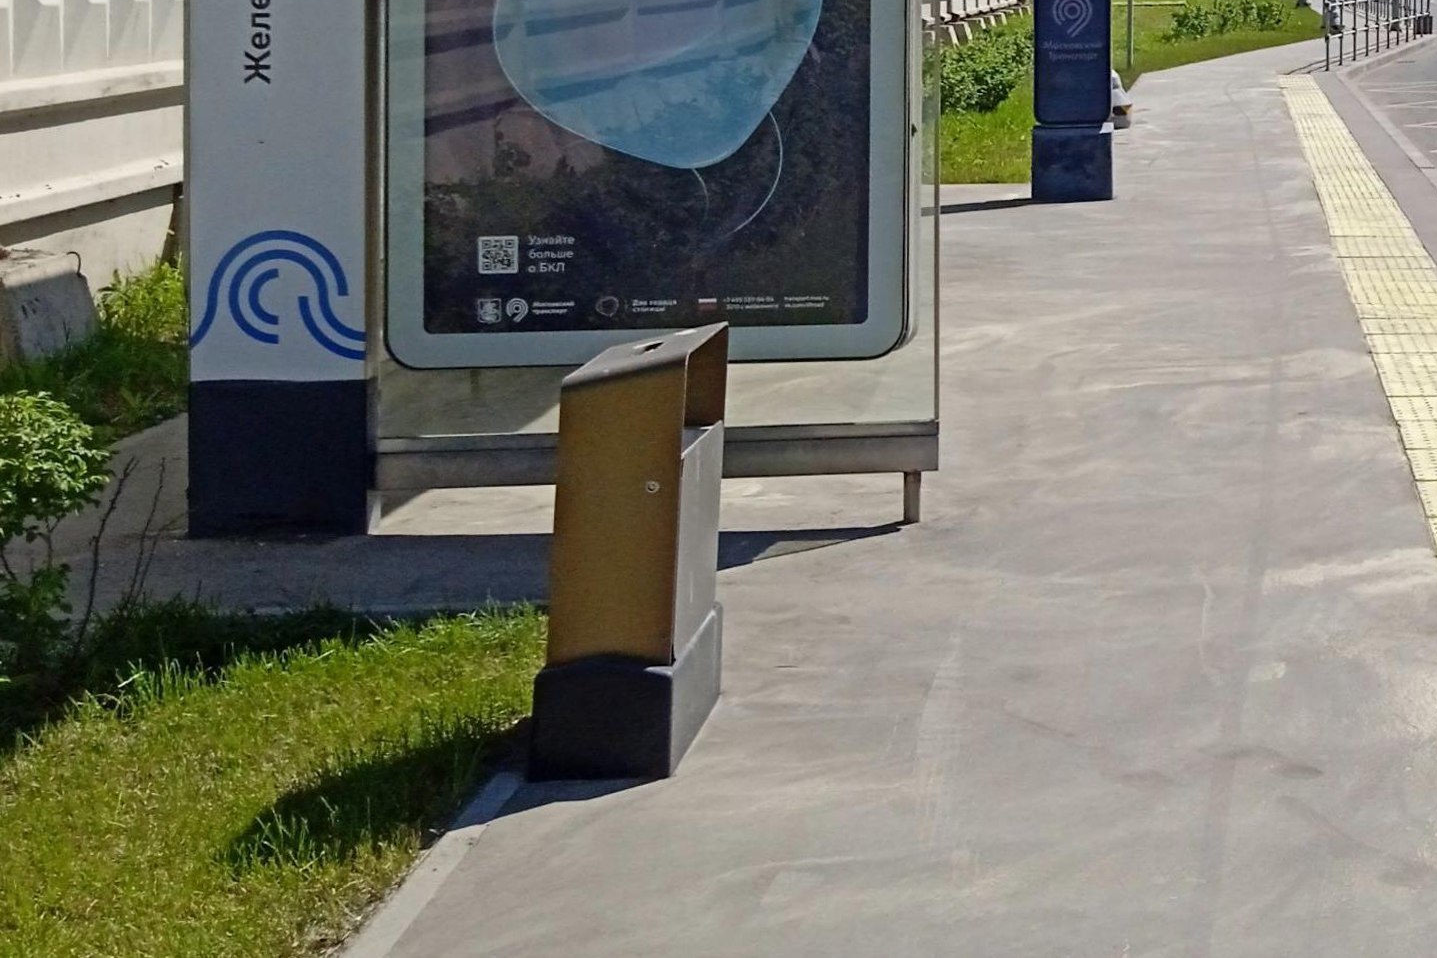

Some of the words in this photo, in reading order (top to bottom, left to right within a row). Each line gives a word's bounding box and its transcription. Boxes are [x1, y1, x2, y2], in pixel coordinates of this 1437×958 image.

[528, 234, 575, 246] Узнайте
[528, 249, 574, 260] больше
[528, 265, 536, 273] о
[539, 262, 566, 273] БКЛ
